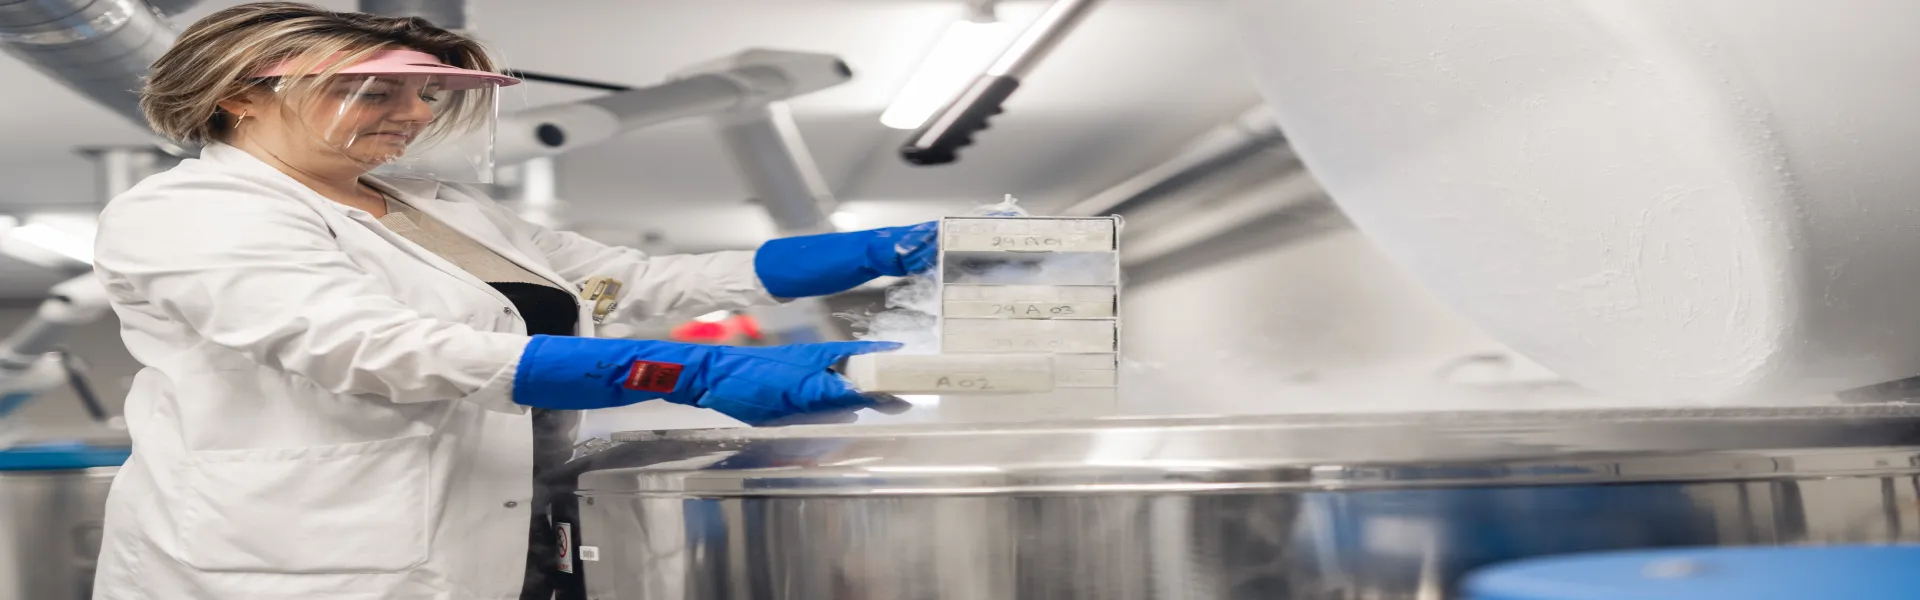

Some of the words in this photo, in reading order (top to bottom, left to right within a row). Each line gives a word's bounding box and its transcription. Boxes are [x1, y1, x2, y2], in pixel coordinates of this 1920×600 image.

[991, 303, 1016, 315] 29
[1025, 304, 1041, 315] A
[1049, 305, 1075, 315] 03
